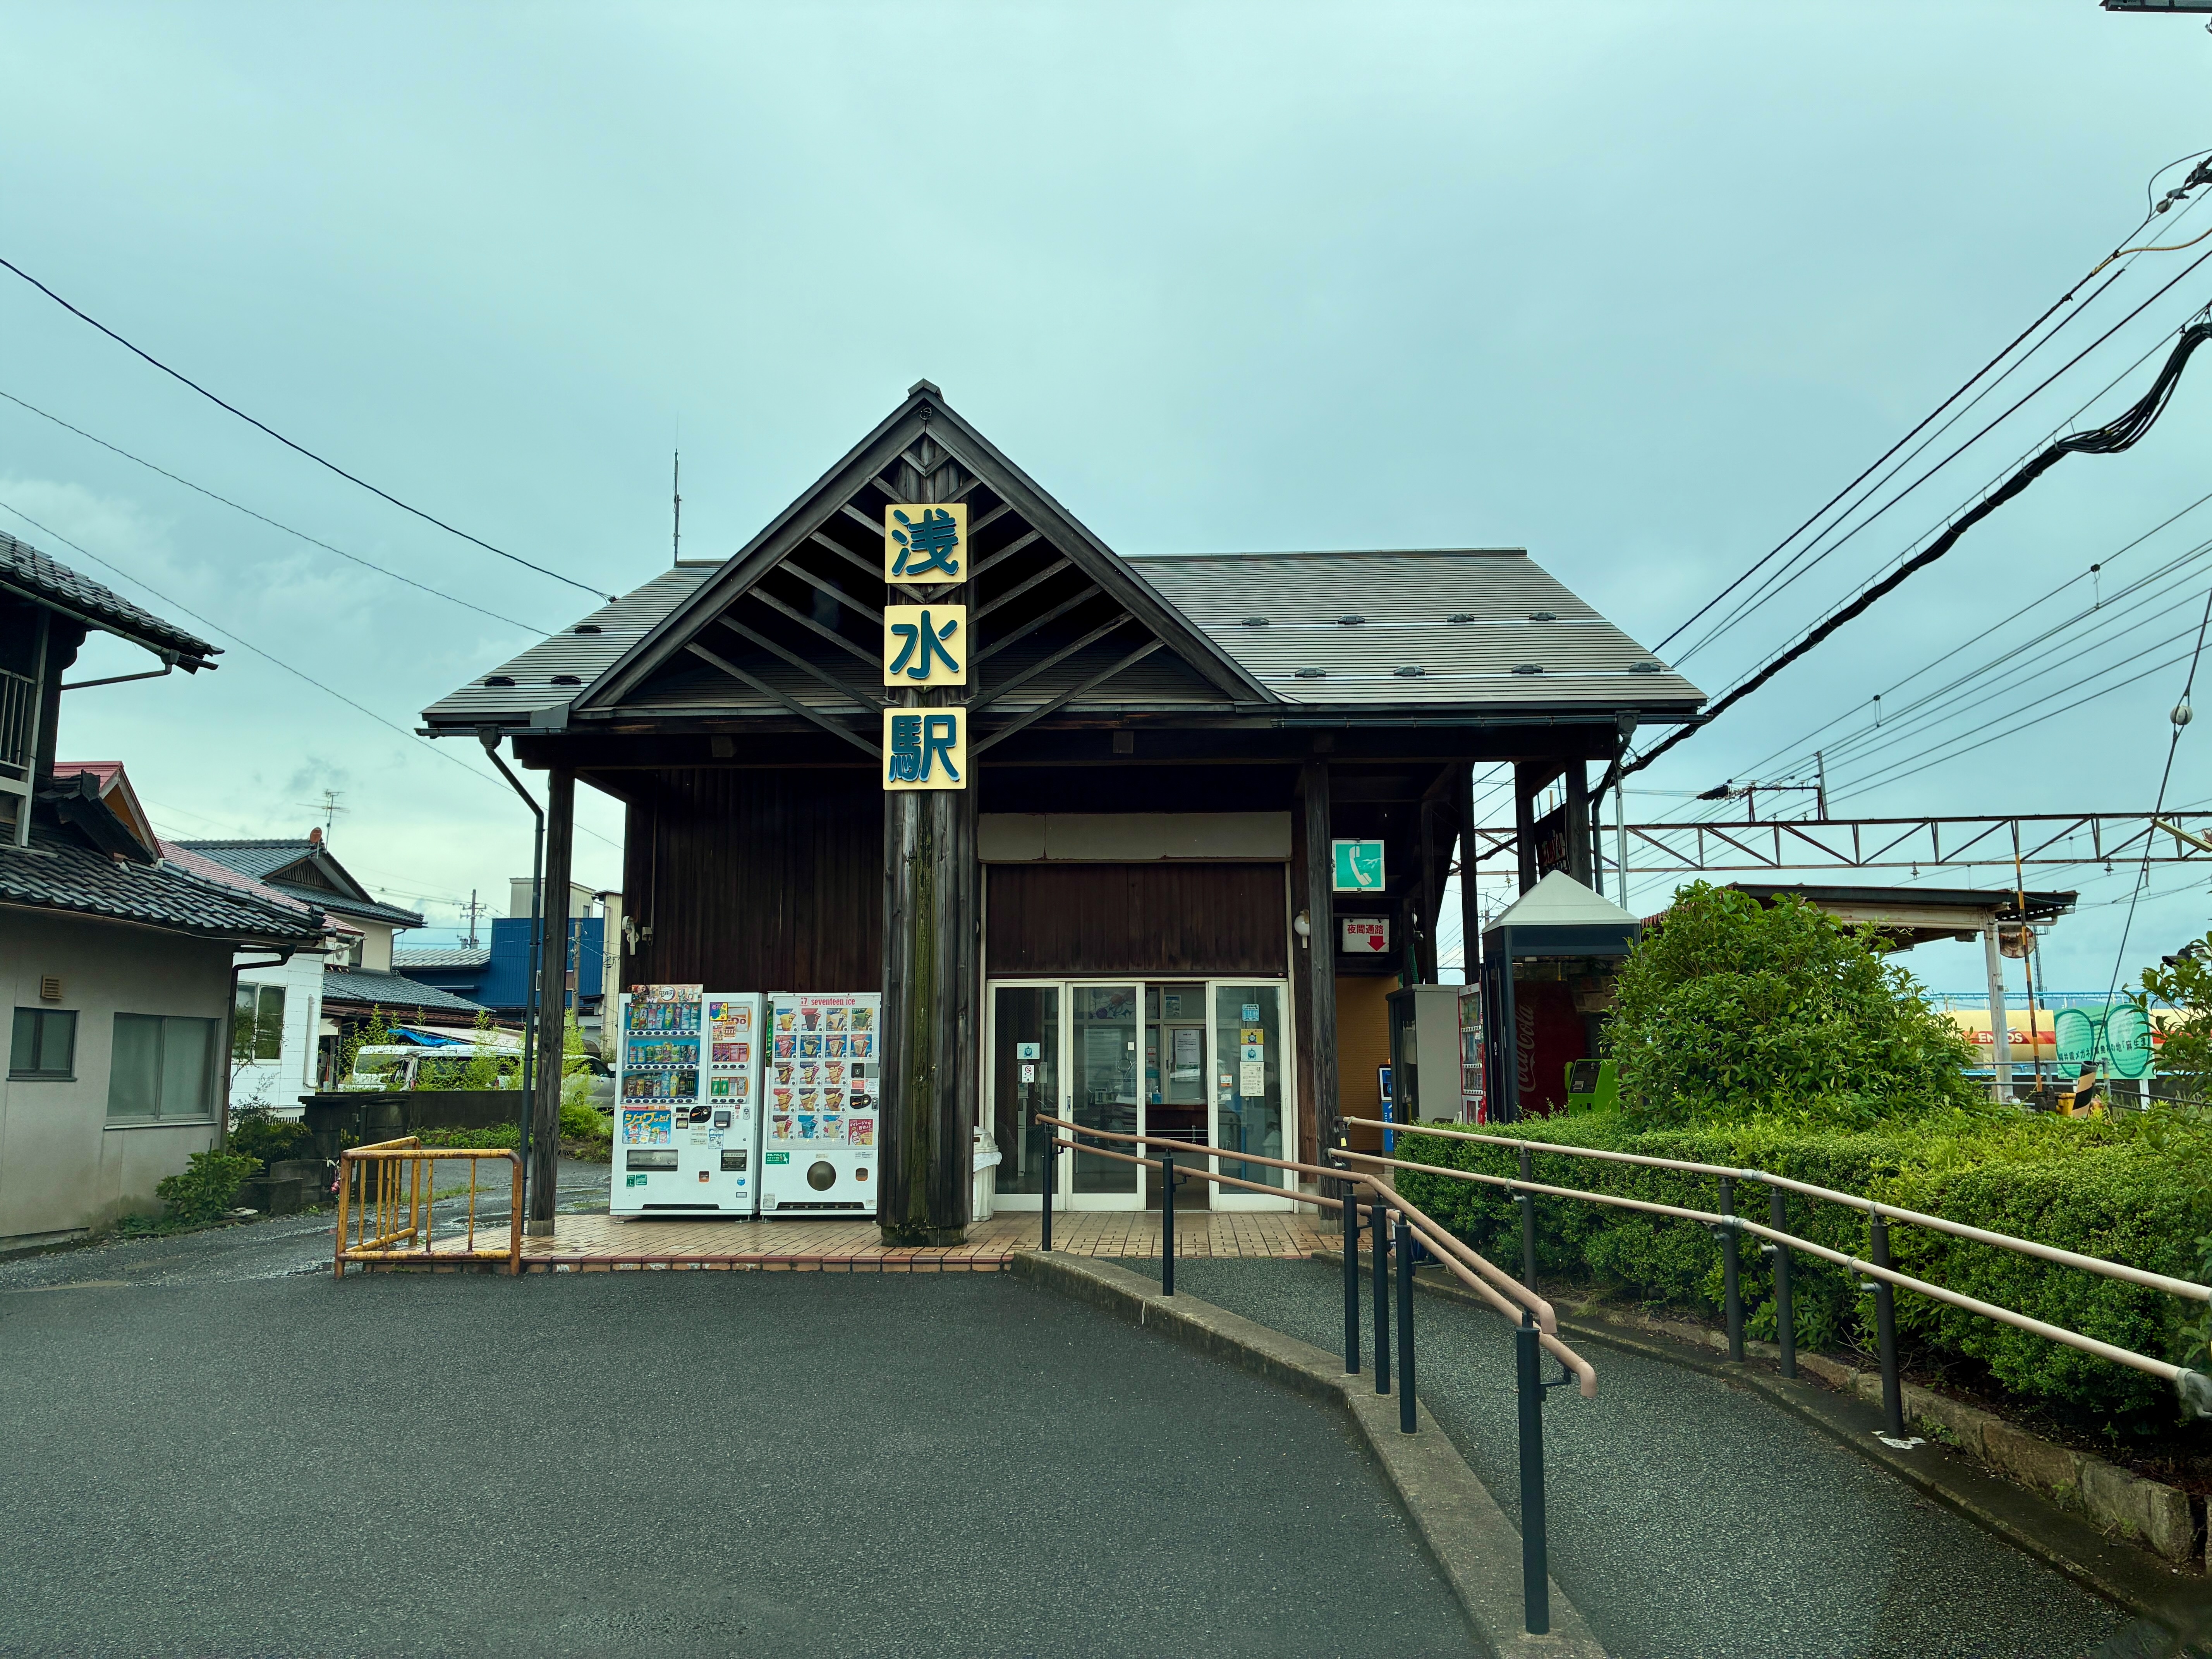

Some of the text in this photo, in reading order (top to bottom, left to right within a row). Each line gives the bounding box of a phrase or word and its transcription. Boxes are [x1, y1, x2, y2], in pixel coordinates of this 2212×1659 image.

[888, 508, 960, 783] 浅水駅
[1347, 924, 1384, 935] 夜間通路
[846, 996, 855, 1005] ice
[1978, 1032, 2023, 1043] ENOS
[1515, 1003, 1536, 1093] CocaCola
